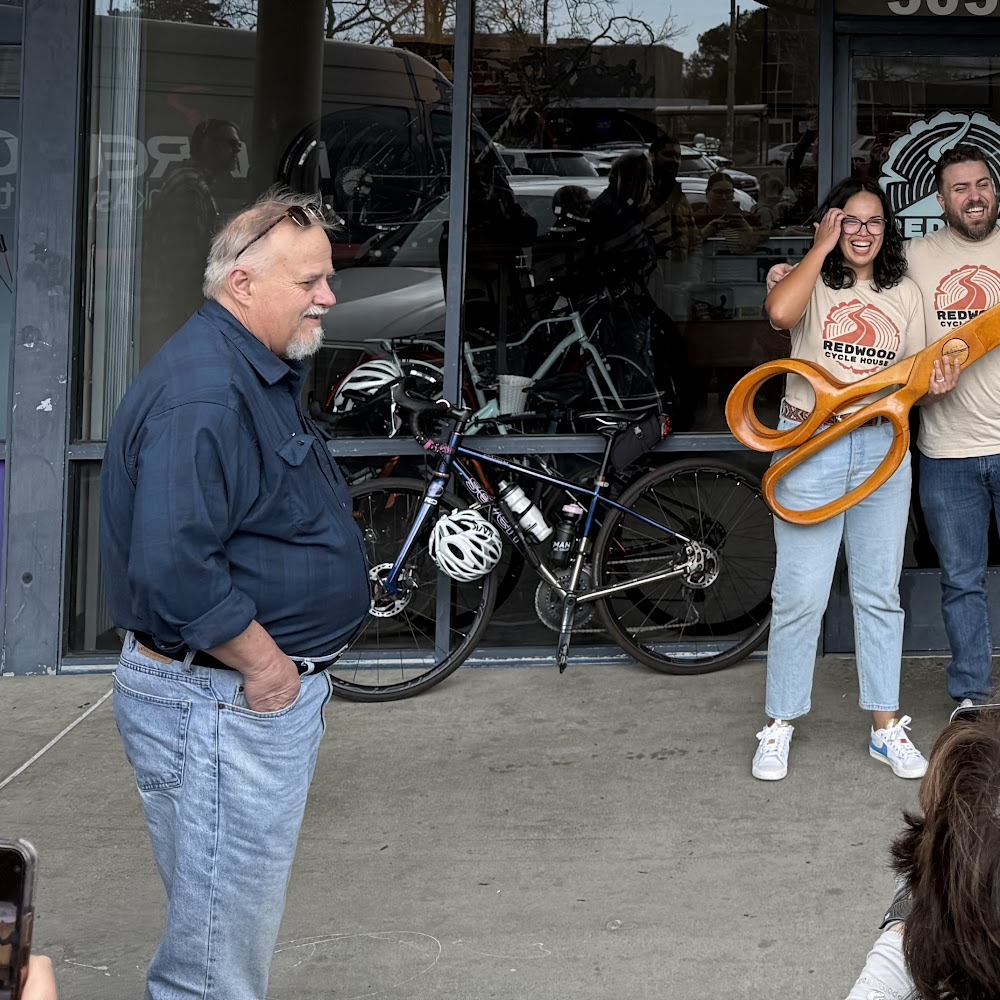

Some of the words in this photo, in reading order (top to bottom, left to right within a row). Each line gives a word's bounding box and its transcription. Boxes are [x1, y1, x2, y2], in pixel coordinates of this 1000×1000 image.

[823, 340, 896, 360] REDWOOD
[824, 351, 857, 362] CYCLE
[860, 357, 889, 366] HOUSE
